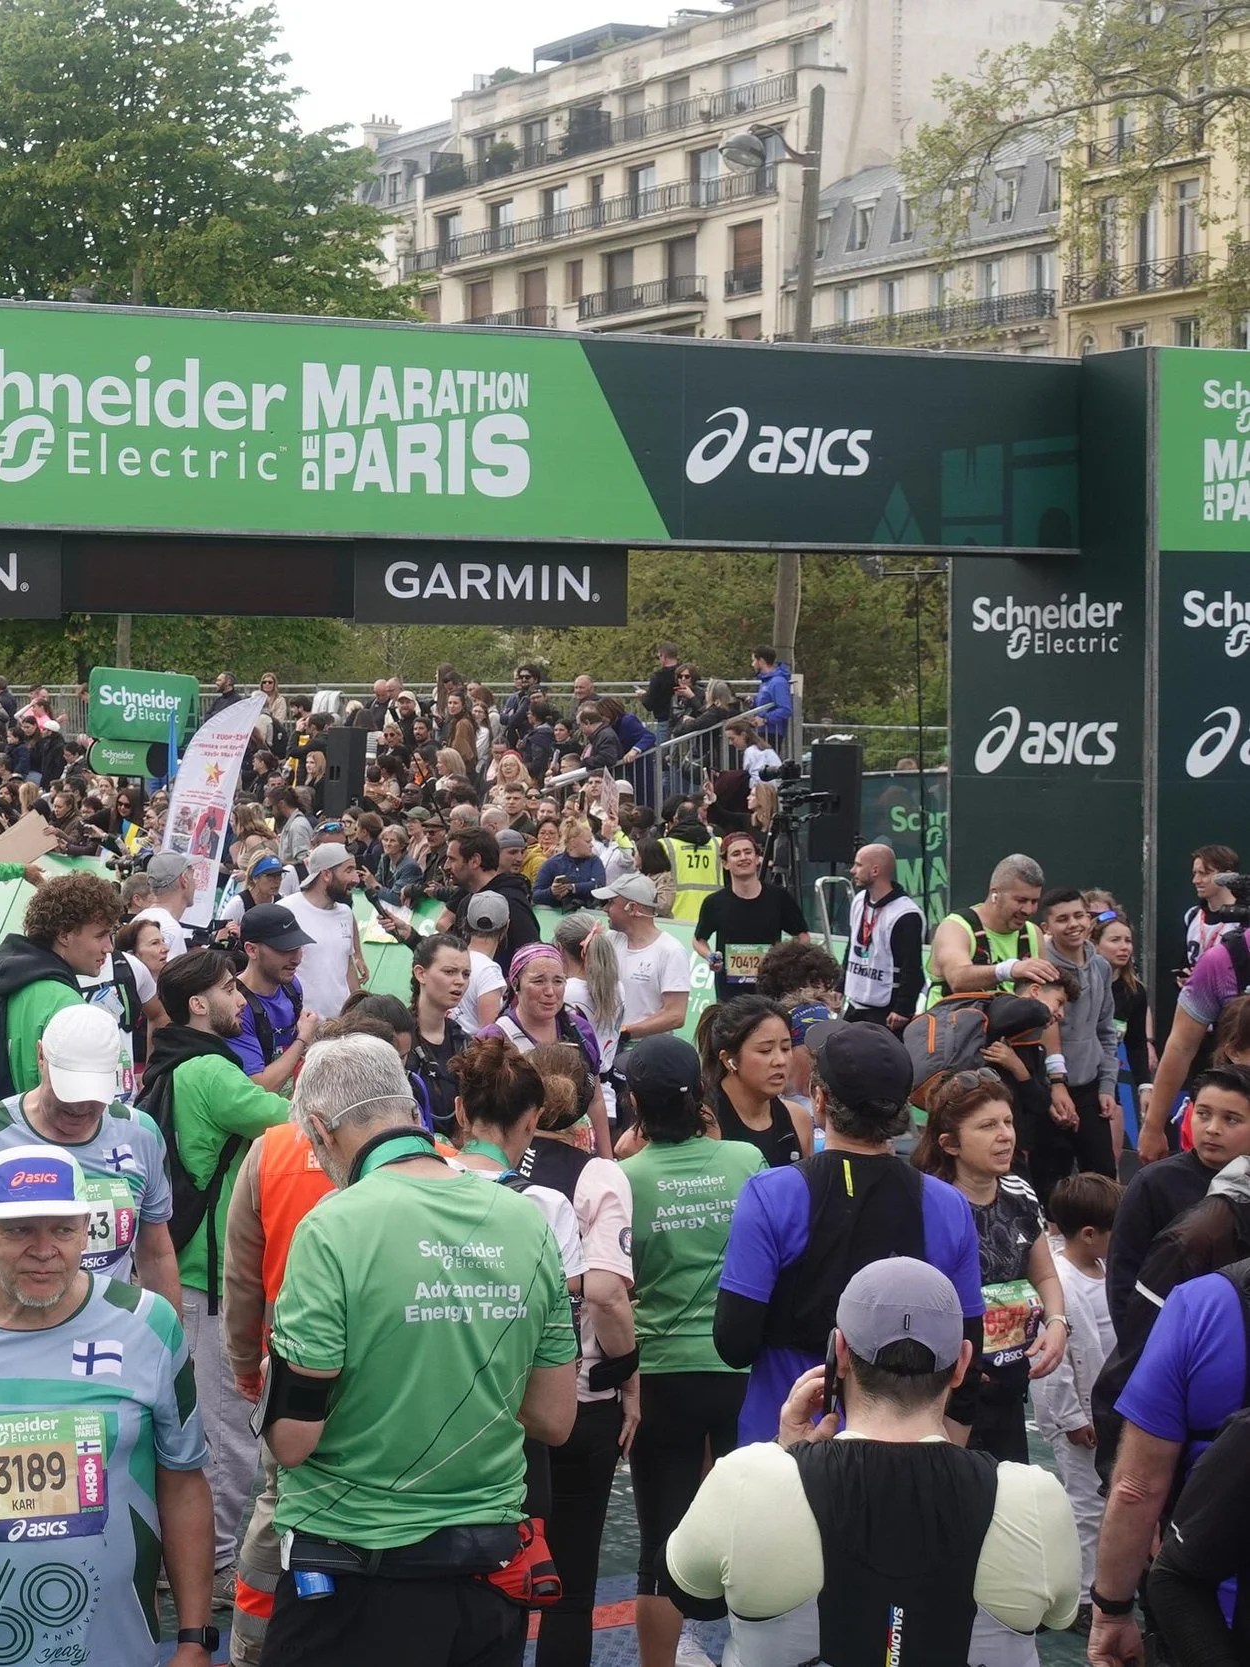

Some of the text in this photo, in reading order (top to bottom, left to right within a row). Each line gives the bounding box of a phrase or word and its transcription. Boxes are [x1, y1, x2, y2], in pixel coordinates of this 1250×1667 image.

[302, 362, 529, 430] MARATHON
[67, 431, 279, 482] Electric
[302, 414, 530, 498] DE PARIS
[748, 426, 872, 476] asics
[384, 562, 591, 602] GARMIN
[972, 593, 1123, 631] Schneider
[1033, 632, 1119, 654] Electric
[99, 685, 182, 711] Schneider
[138, 706, 179, 723] Electrc
[1020, 721, 1117, 765] asics
[101, 749, 135, 760] Schneider
[686, 854, 710, 869] 270
[657, 1175, 726, 1193] Schneider
[688, 1184, 727, 1196] Electric
[656, 1198, 738, 1219] Advancing
[119, 1209, 130, 1242] 4H30+
[651, 1215, 706, 1233] Energy
[418, 1239, 504, 1260] Schneider
[455, 1258, 506, 1270] Electric
[414, 1281, 522, 1302] Advancing
[404, 1301, 527, 1325] Energy Tech
[11, 1431, 58, 1442] Electric
[84, 1457, 98, 1503] 4H30+
[12, 1498, 36, 1512] KARI
[890, 1606, 904, 1667] SALOMO
